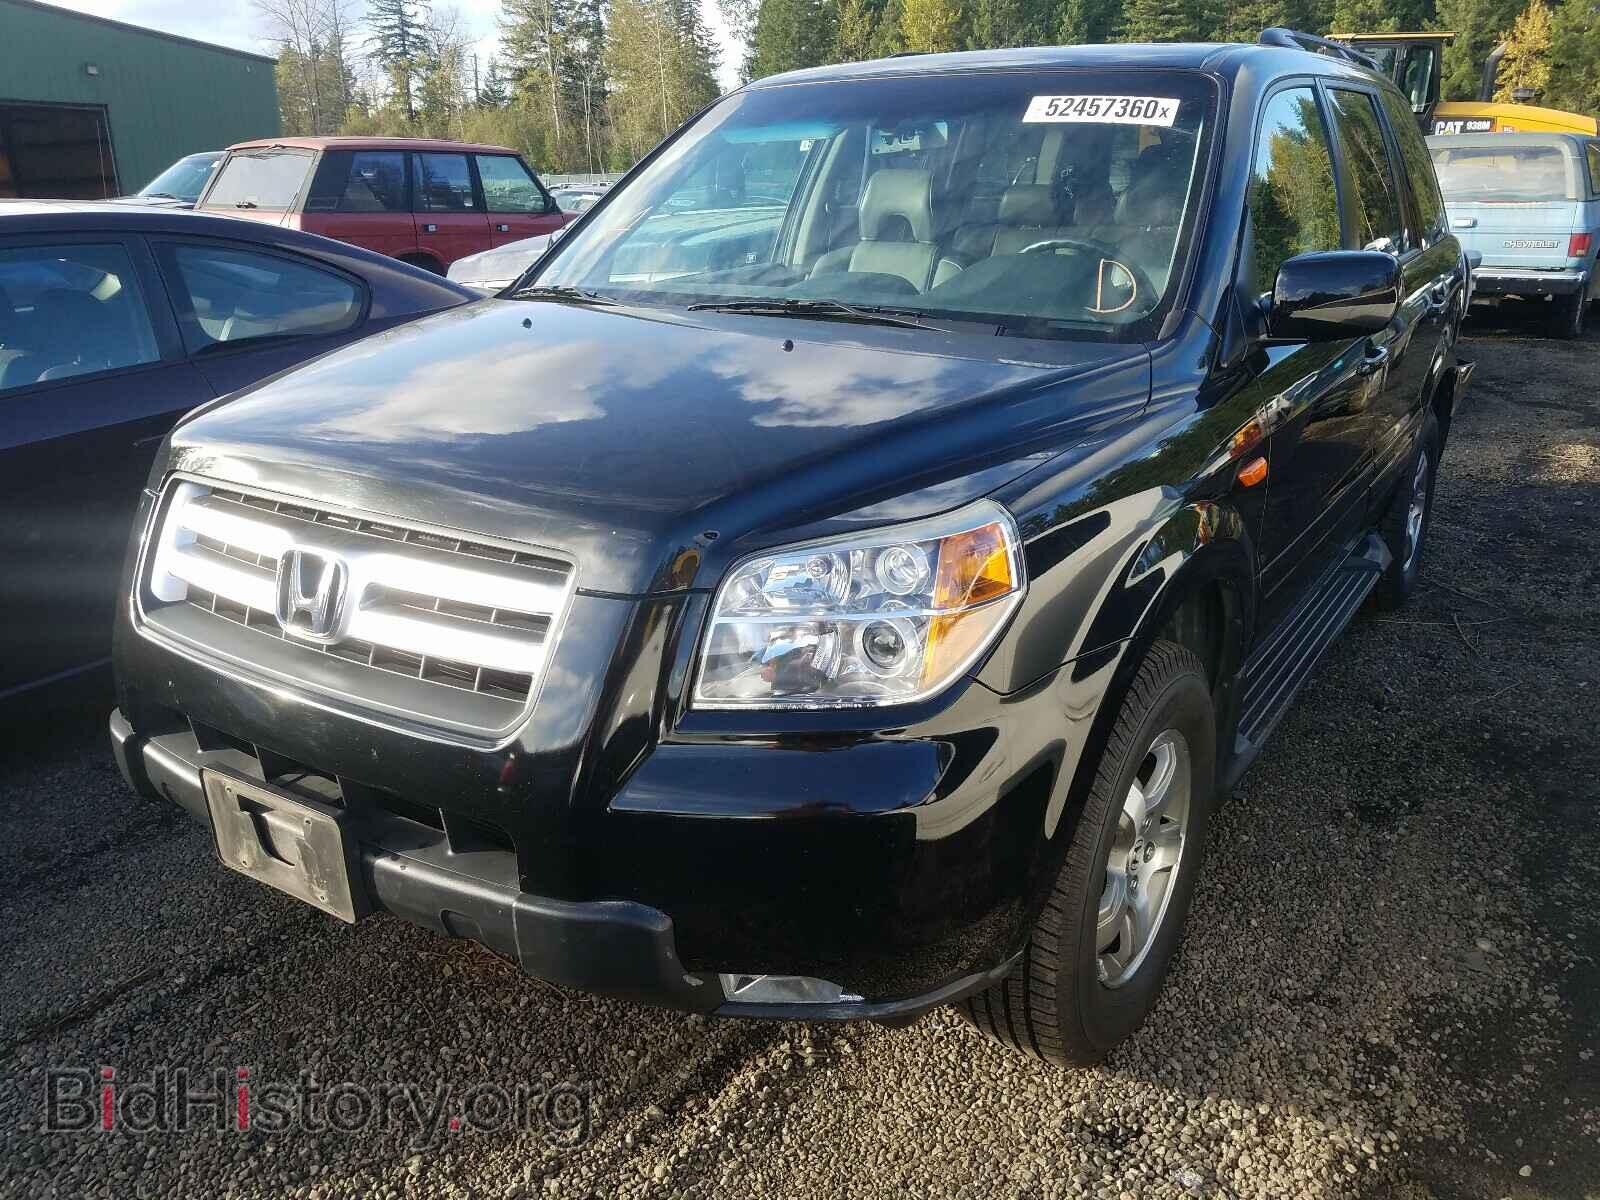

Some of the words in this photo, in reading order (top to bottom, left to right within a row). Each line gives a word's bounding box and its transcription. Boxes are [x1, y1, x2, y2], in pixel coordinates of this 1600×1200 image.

[1435, 121, 1464, 136] CAT
[1502, 239, 1561, 249] CHEVROLET
[1085, 258, 1137, 313] D
